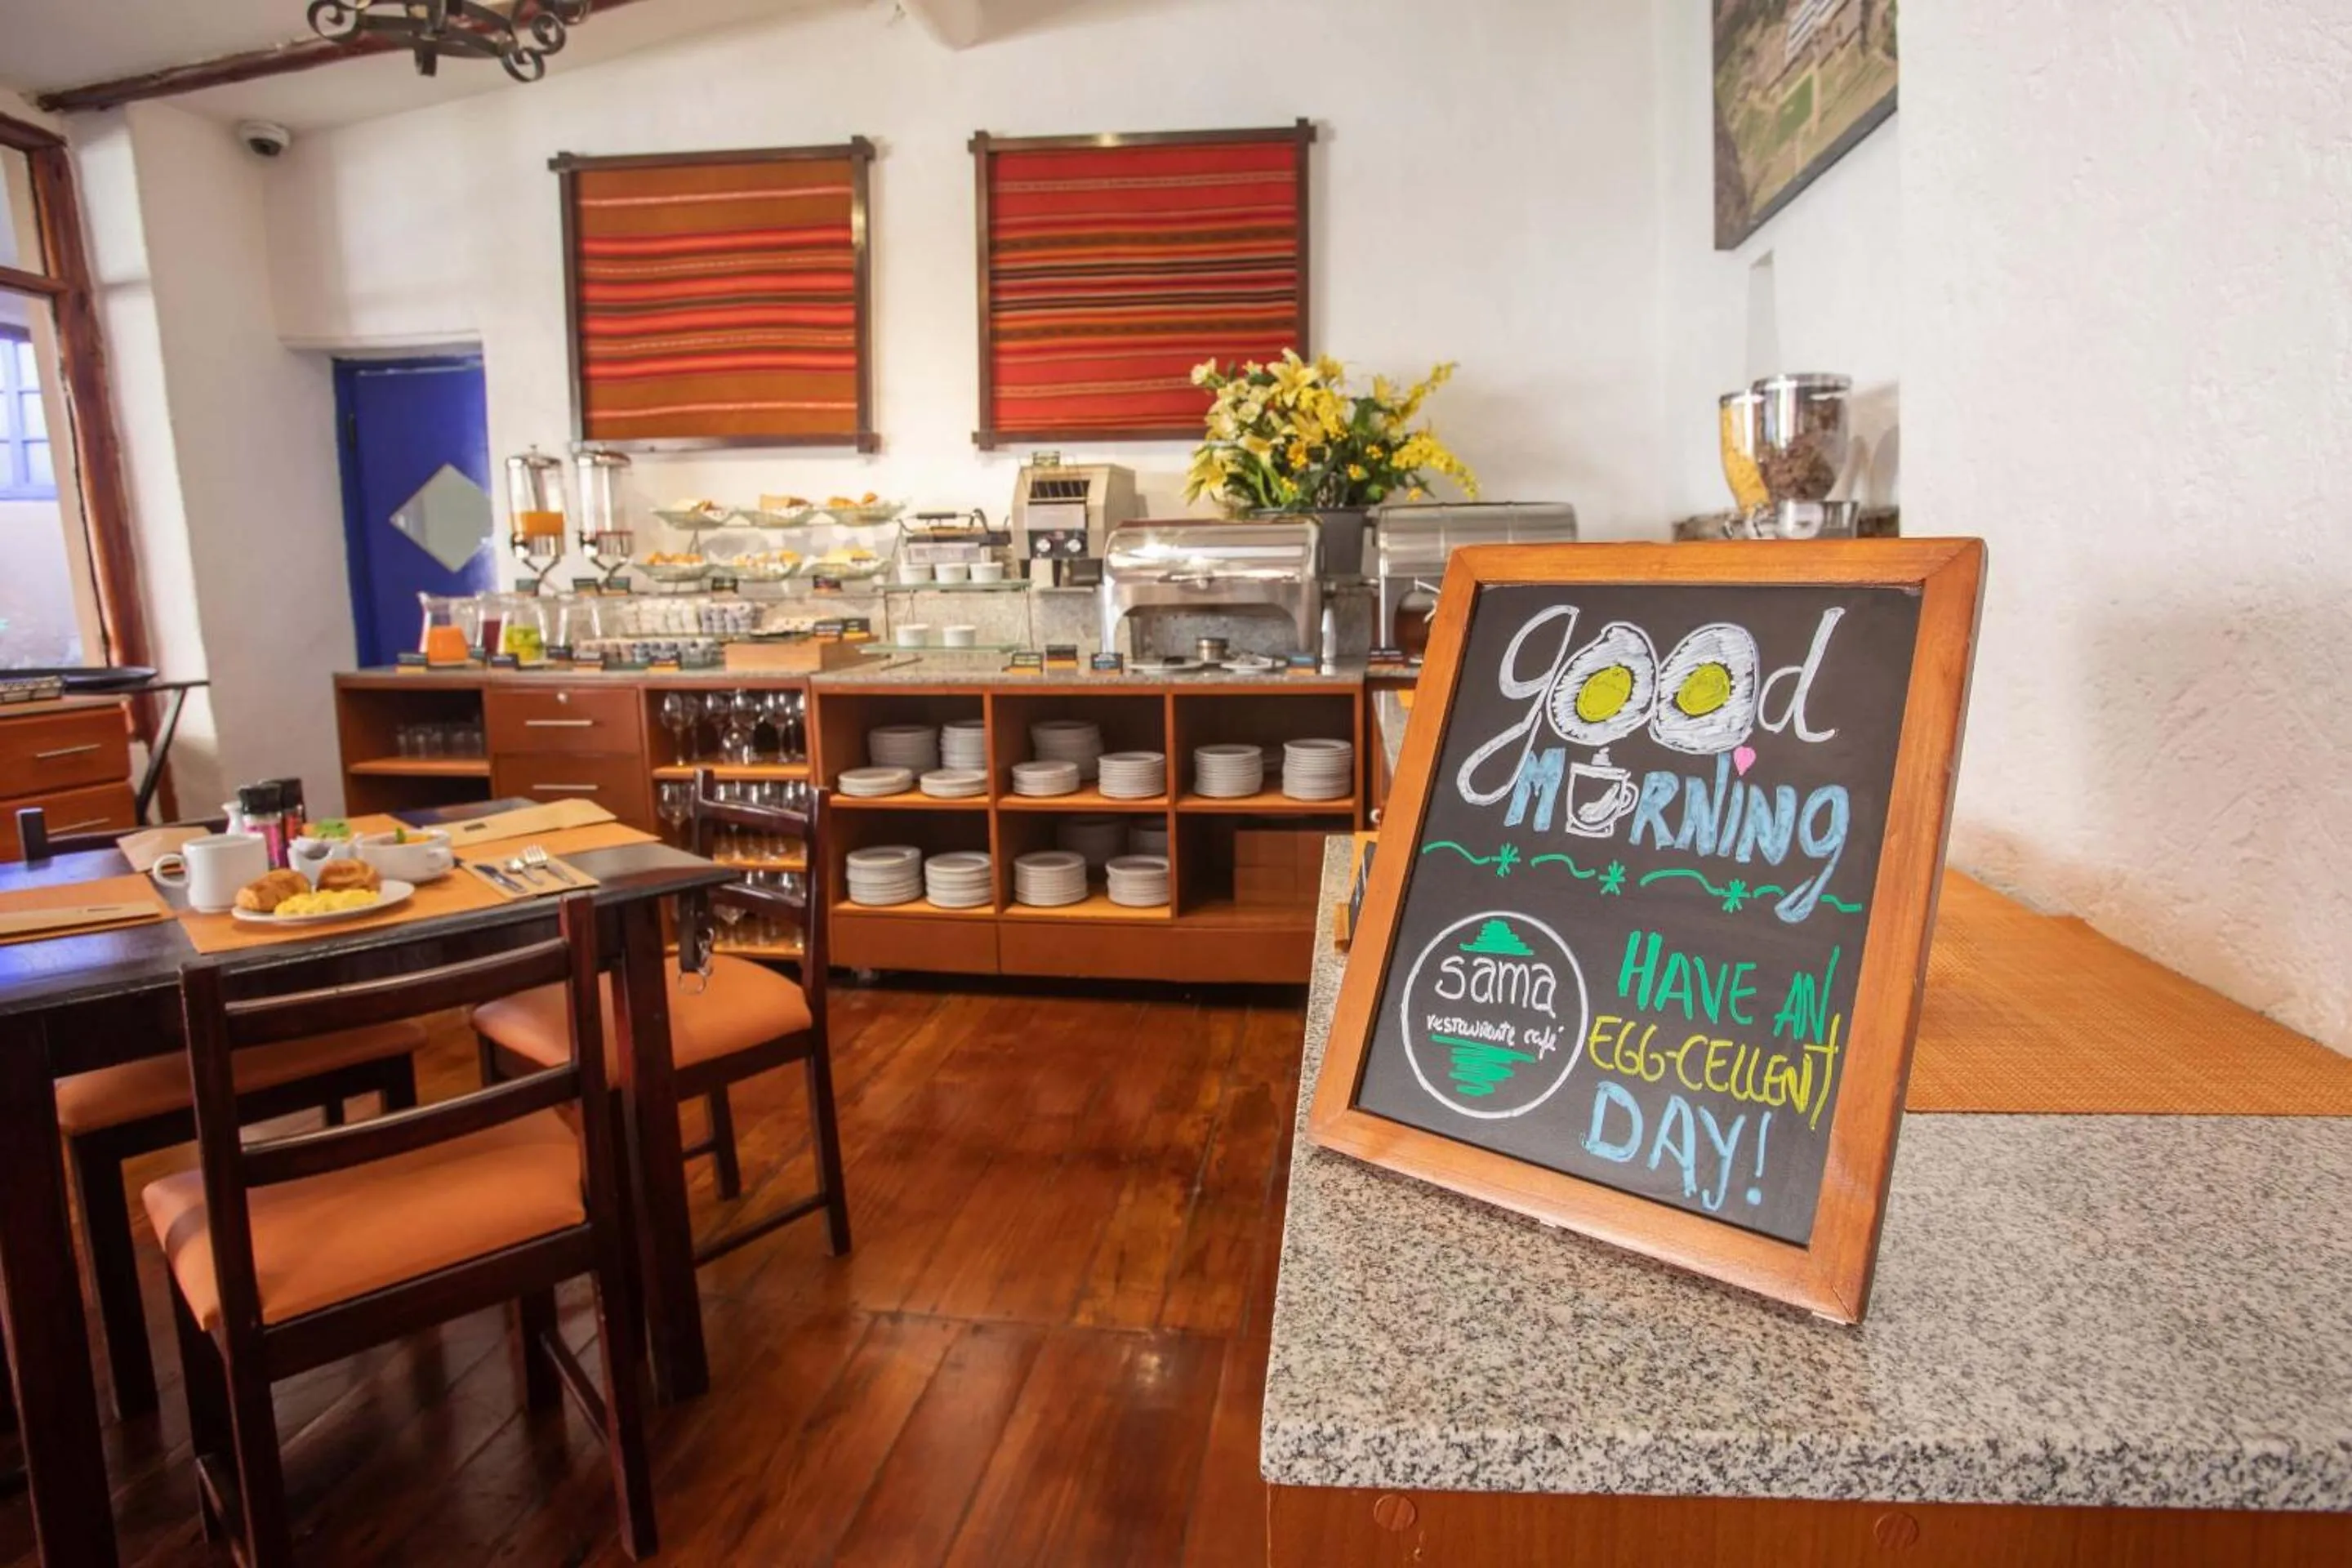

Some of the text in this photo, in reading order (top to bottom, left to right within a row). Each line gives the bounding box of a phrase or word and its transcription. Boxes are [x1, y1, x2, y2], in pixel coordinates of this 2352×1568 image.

[1457, 604, 1846, 806] good
[1435, 955, 1557, 1019] sama
[1617, 930, 1840, 1045] HAVE AN
[1588, 1013, 1841, 1131] EGG-CELLENT
[1581, 1080, 1772, 1212] DAY!
